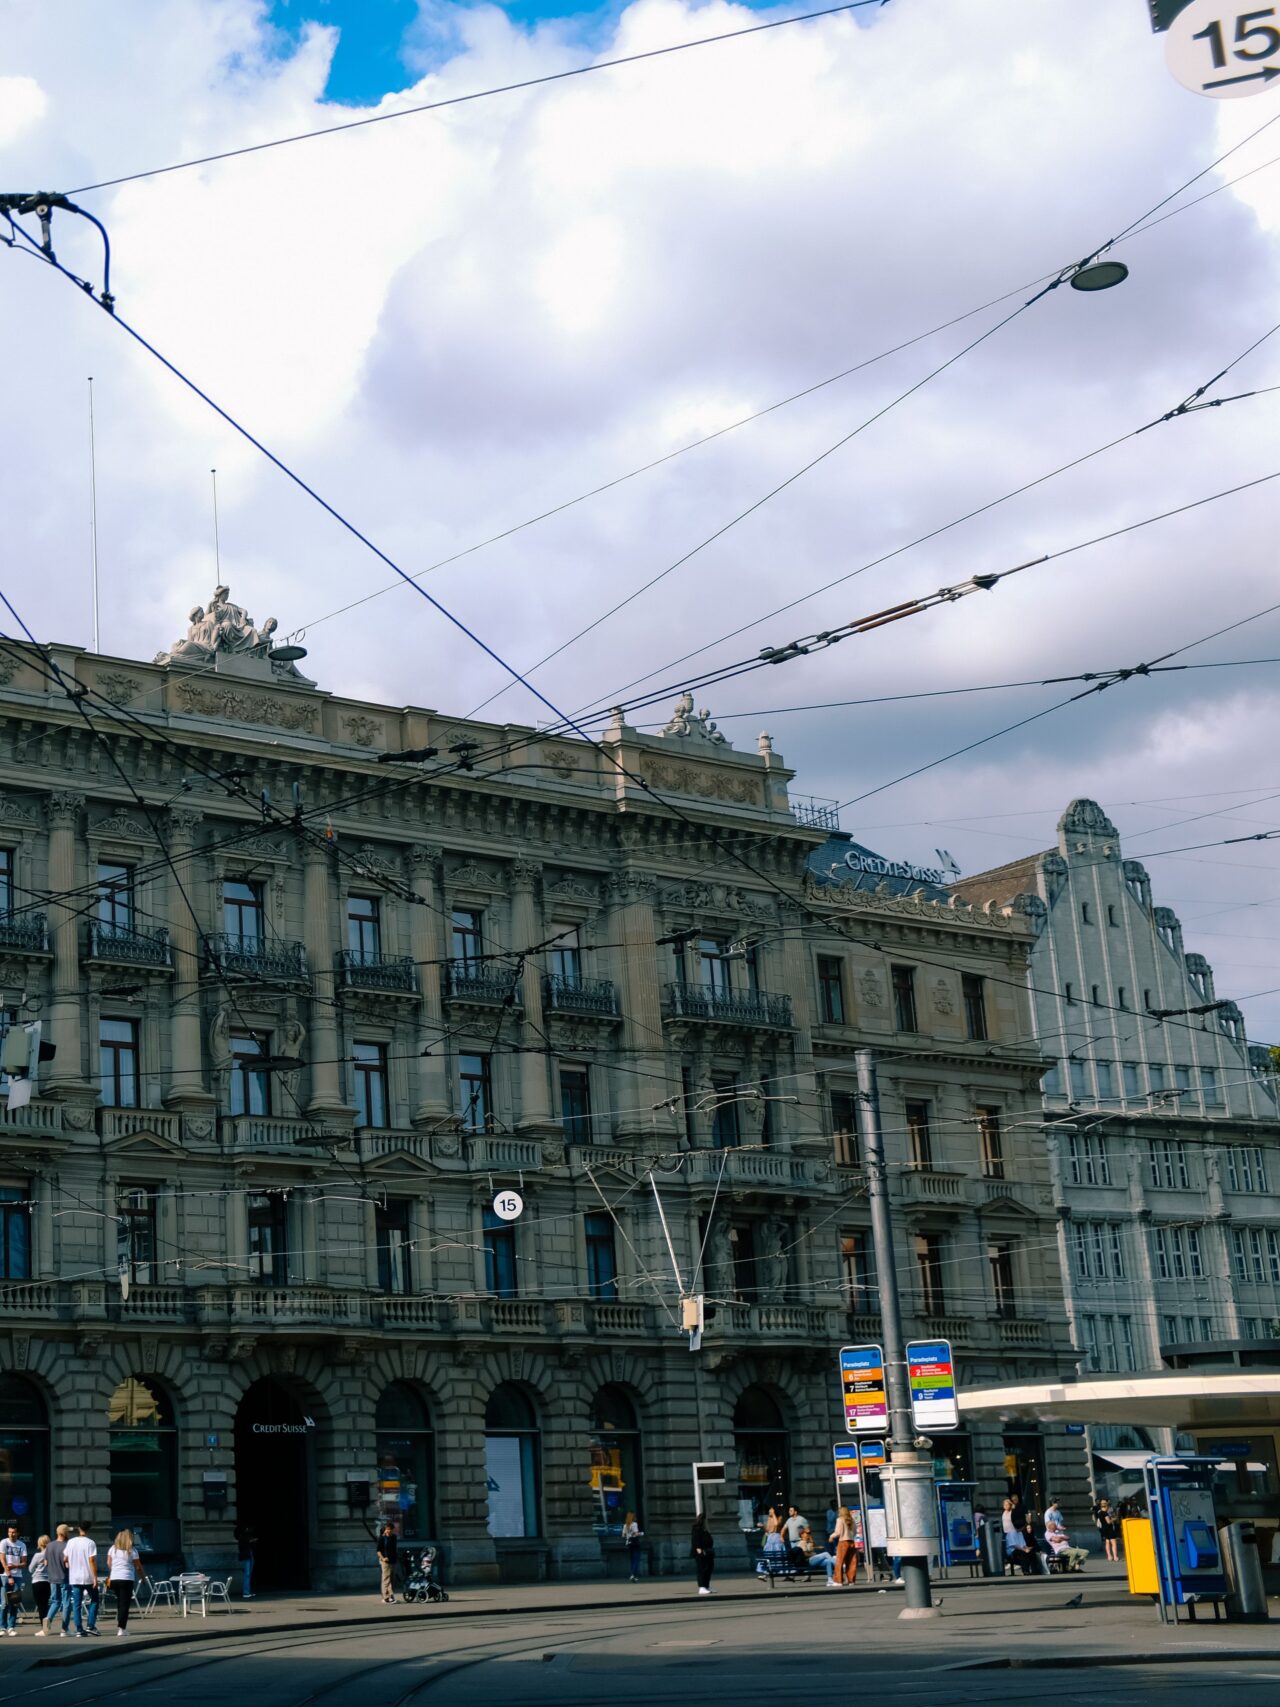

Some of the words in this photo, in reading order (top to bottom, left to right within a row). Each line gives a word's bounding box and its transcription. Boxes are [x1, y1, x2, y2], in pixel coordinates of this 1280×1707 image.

[1192, 7, 1280, 69] 15
[845, 851, 900, 876] CREDIT
[499, 1198, 517, 1212] 15
[916, 1369, 921, 1377] 2
[849, 1385, 855, 1393] 7
[918, 1392, 924, 1400] 9
[849, 1408, 856, 1416] 17
[252, 1423, 281, 1433] CREDIT
[282, 1423, 307, 1433] SUISSE
